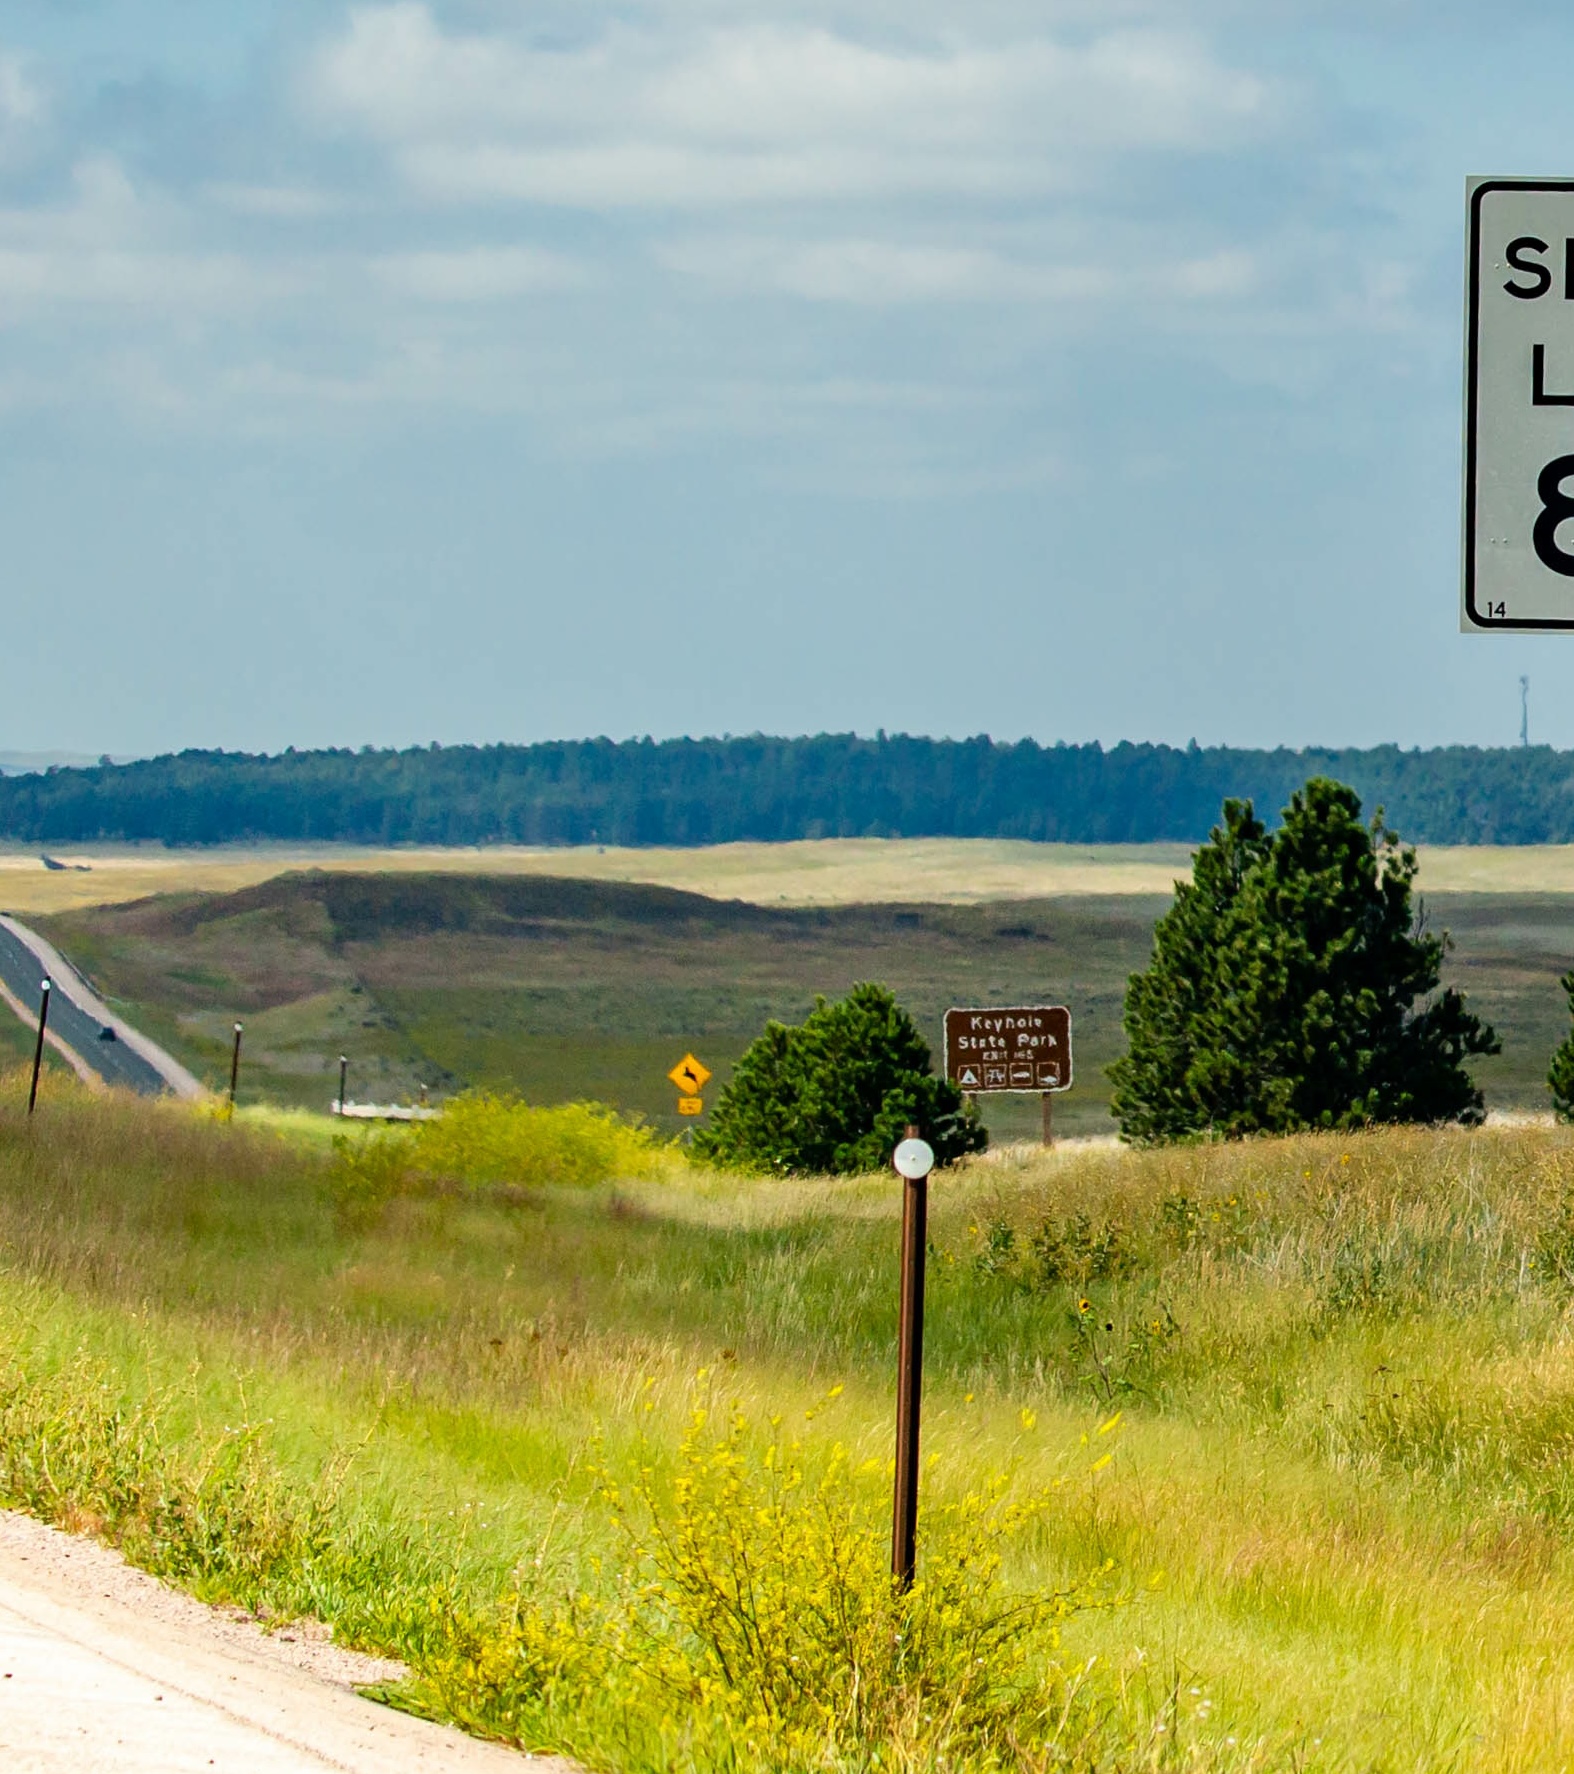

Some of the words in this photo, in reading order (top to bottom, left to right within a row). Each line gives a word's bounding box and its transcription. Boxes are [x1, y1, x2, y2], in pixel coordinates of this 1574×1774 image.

[1487, 601, 1506, 618] 14
[971, 1016, 1042, 1033] Keyhole
[958, 1035, 1006, 1049] State
[1017, 1033, 1057, 1047] Park
